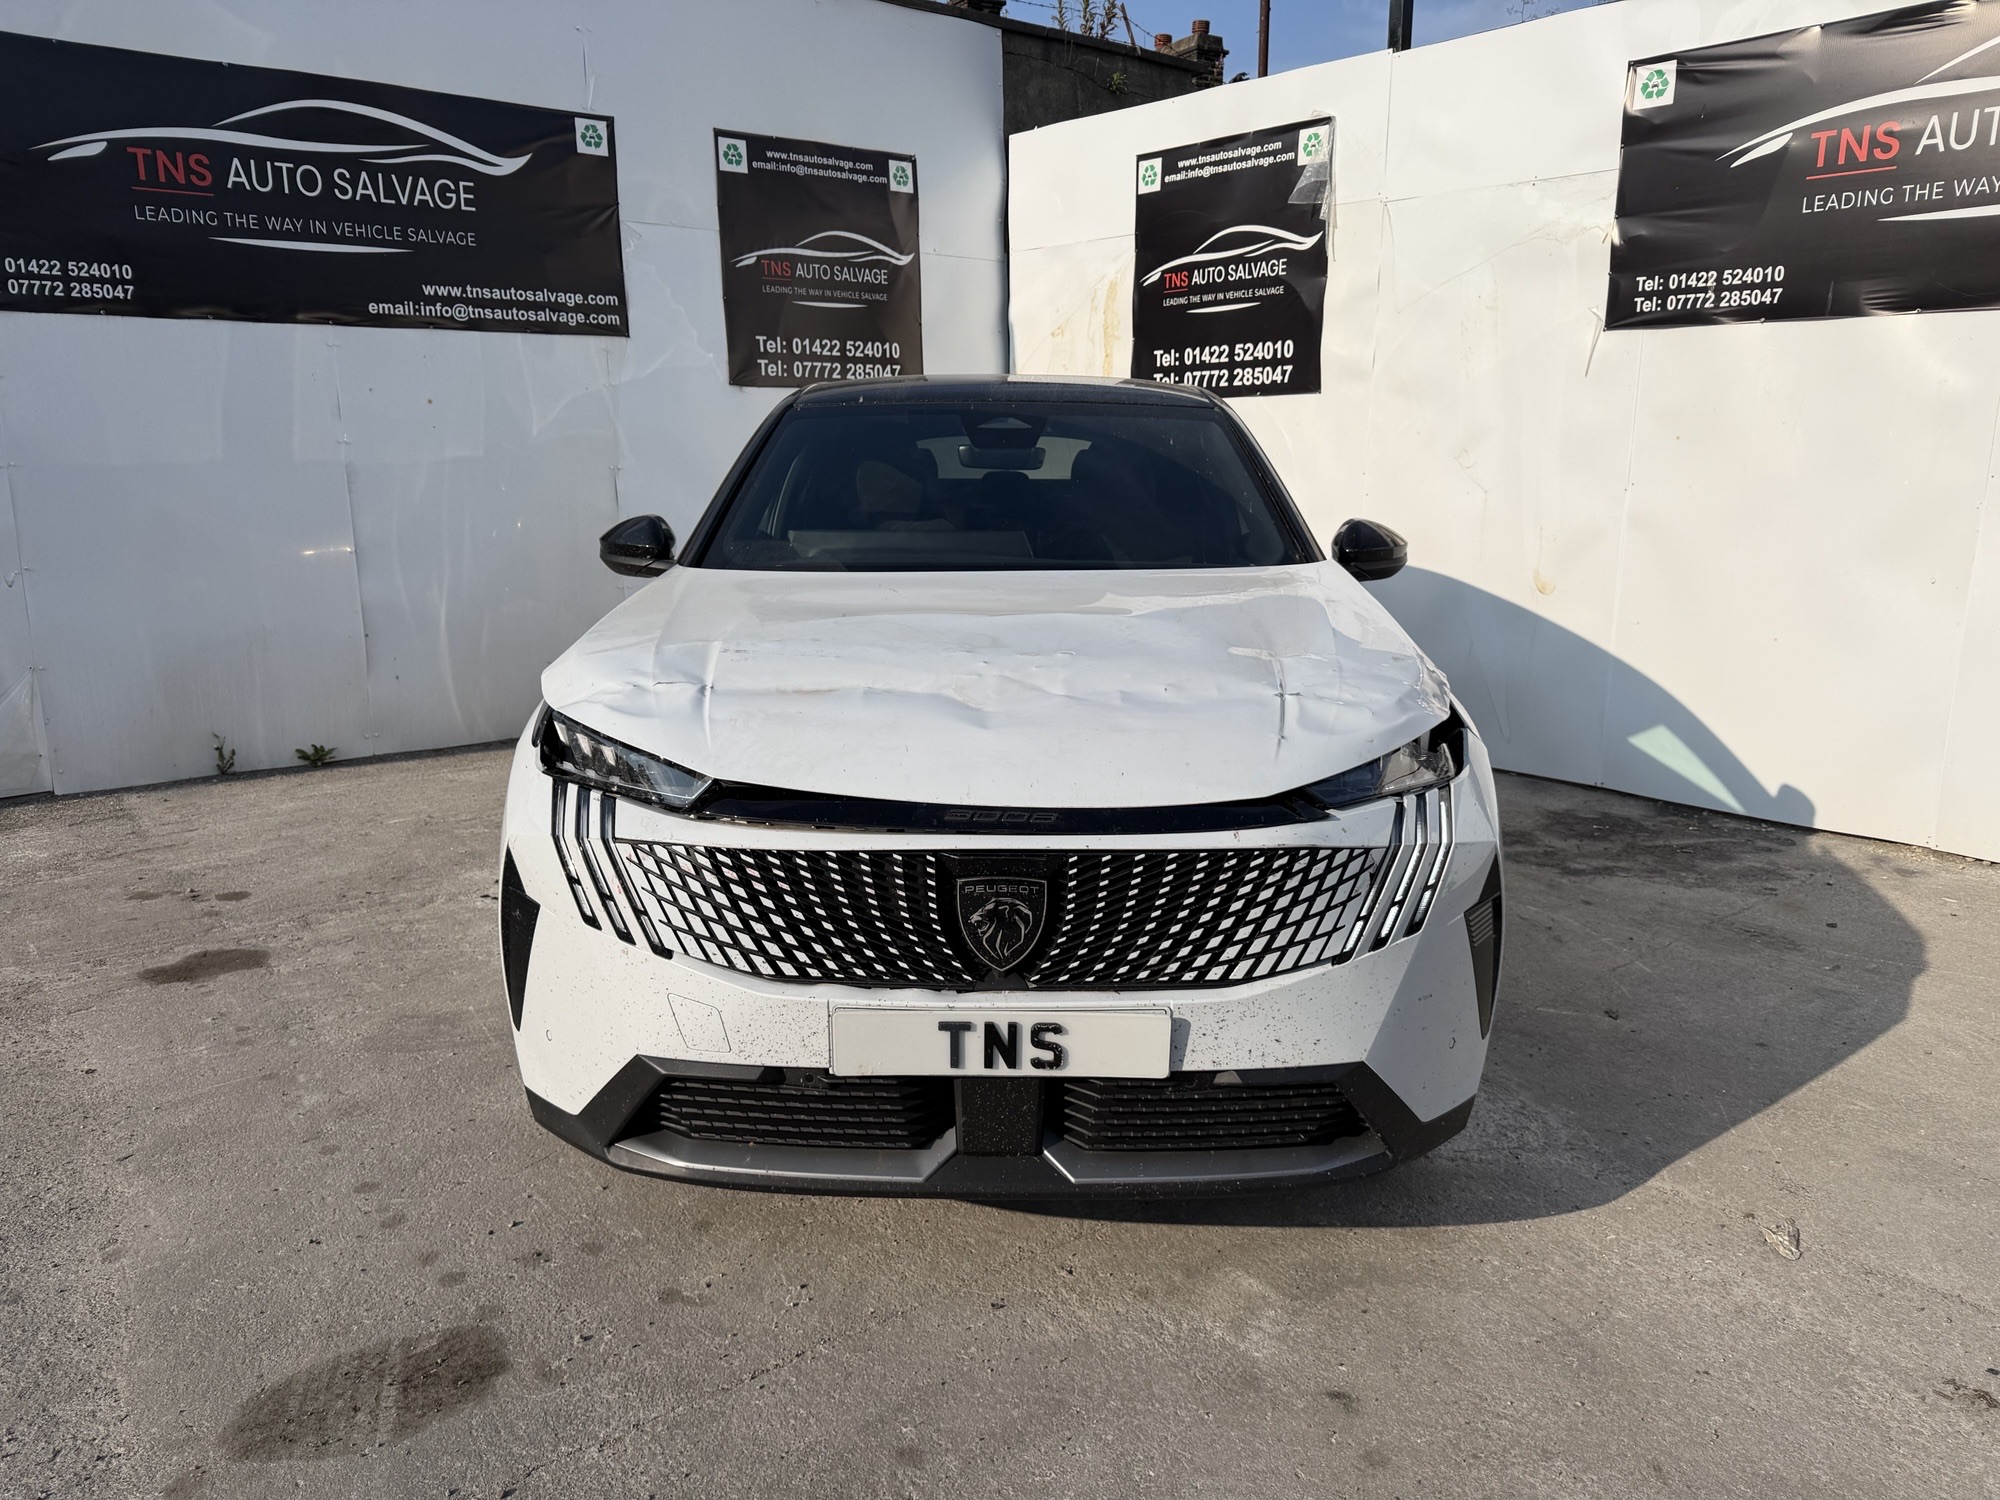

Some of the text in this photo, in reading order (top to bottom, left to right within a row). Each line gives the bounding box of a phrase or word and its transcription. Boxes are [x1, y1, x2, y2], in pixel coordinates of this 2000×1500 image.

[1177, 141, 1282, 168] www.tnsautosalvage.com
[1811, 120, 1901, 168] TNS
[752, 160, 887, 184] email:info@tnsautosalvage.com
[766, 150, 873, 171] www.tnsautosalvage.com
[1164, 151, 1295, 183] email:info@tnsautosalvage.com
[127, 147, 476, 212] TNS AUTO SALVAGE
[1802, 186, 1894, 214] LEADING
[1902, 181, 1945, 203] THE
[133, 204, 477, 247] LEADING THE WAY IN VEHICLE SALVAGE
[5, 257, 132, 279] 01422 524010
[761, 260, 888, 284] TNS AUTO SALVAGE
[1163, 258, 1287, 288] TNS AUTO SALVAGE
[1636, 265, 1785, 292] Tel: 01422 524010
[7, 279, 134, 300] 07772 285047
[422, 284, 618, 307] www.tnsautosalvage.com
[762, 284, 888, 301] LEADING THE WAY IN VEHICLE SALVAGE
[1163, 286, 1284, 307] LEADING THE WAY IN VEHICLE SALVAGE
[1634, 287, 1783, 313] Tel: 07772 285047
[368, 301, 621, 325] email:info@tnsautosalvage.com
[755, 335, 900, 359] Tel: 01422 524010
[1153, 339, 1293, 367] Tel: 01422 524010
[757, 359, 901, 380] Tel: 07772 285047
[1184, 369, 1228, 388] 07772
[1233, 365, 1293, 386] 285047
[944, 809, 1058, 823] 3008
[964, 884, 1040, 895] PEUGEOT
[938, 1021, 1064, 1070] TNS
